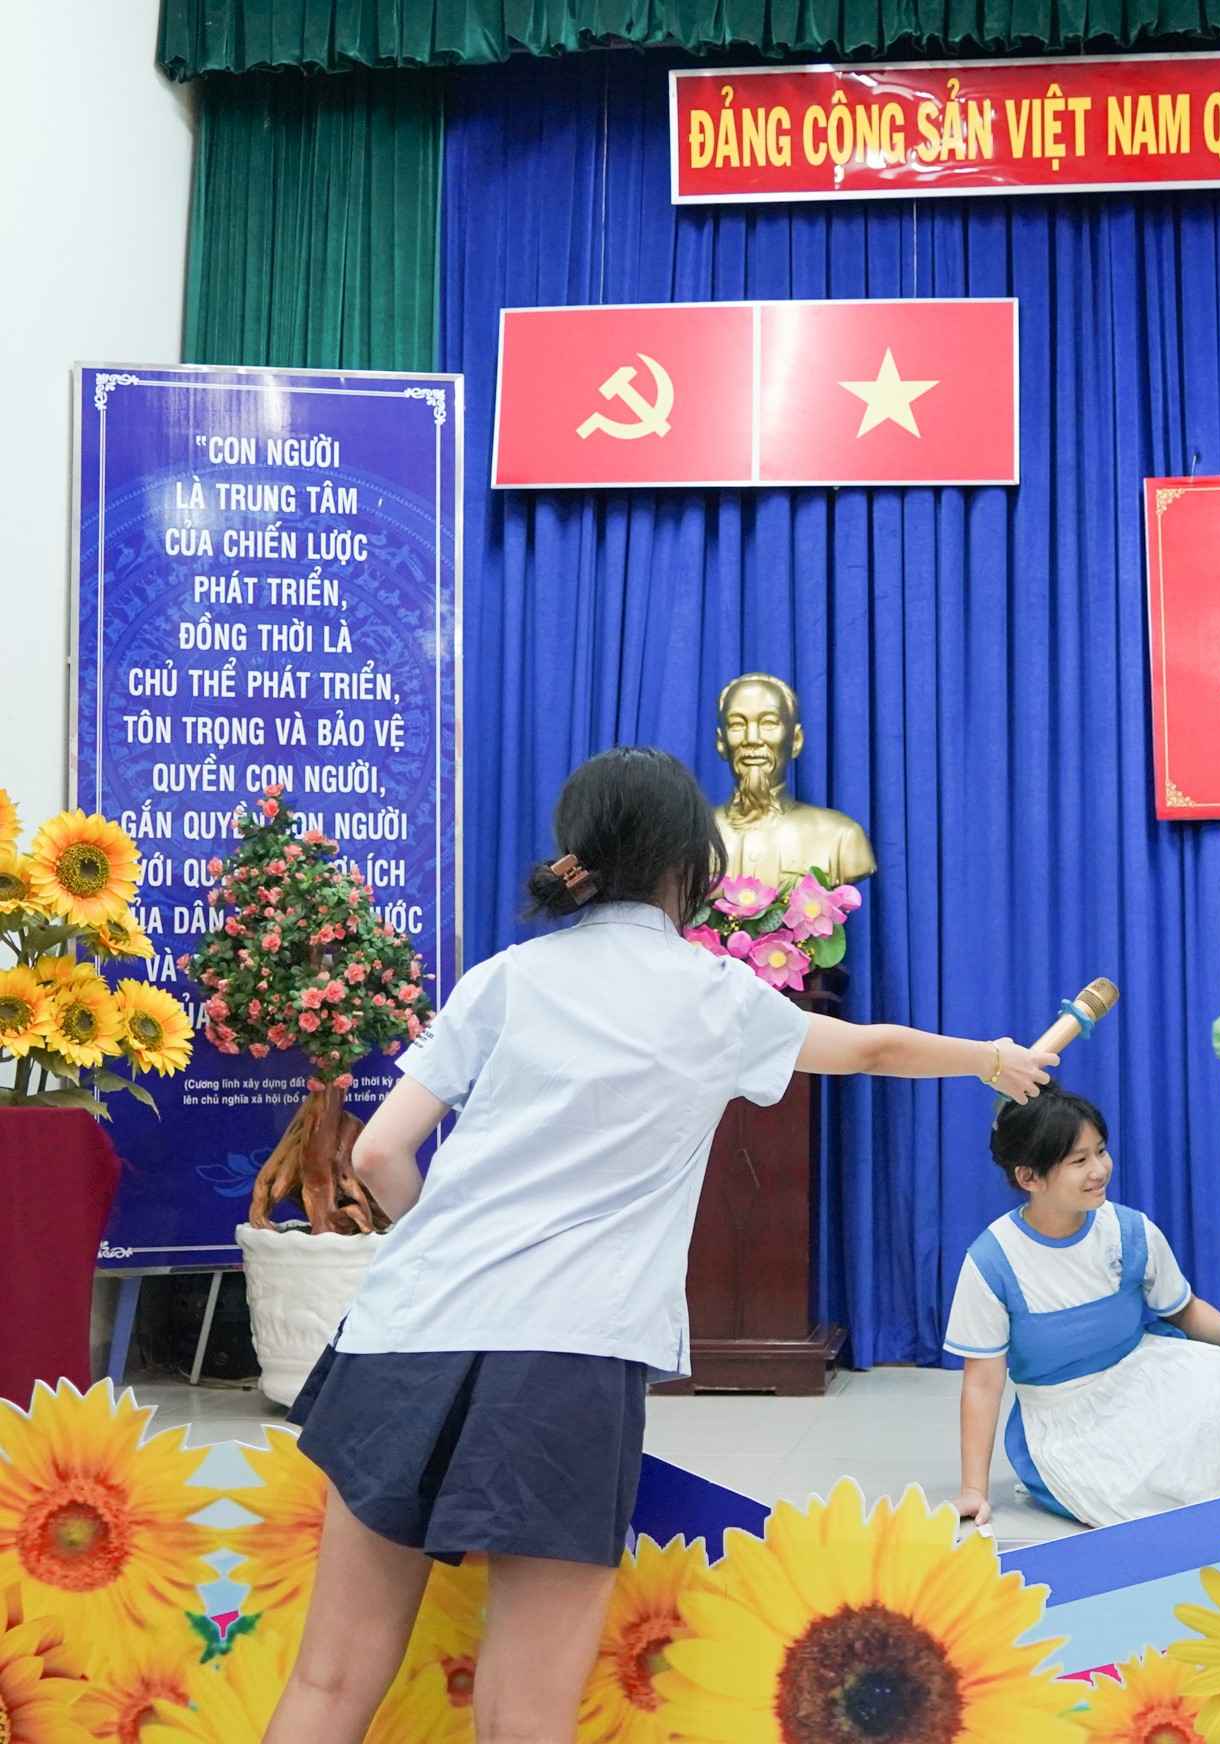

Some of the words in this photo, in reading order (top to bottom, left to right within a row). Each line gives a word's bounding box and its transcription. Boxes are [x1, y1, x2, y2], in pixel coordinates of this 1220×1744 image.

[689, 85, 792, 168] ĐẢNG
[803, 90, 905, 185] CỘNG
[917, 78, 994, 162] SẢN
[1005, 83, 1092, 171] VIỆT
[1107, 94, 1191, 156] NAM
[267, 434, 340, 468] NGƯỜI
[176, 476, 204, 511] LÀ
[216, 483, 296, 514] TRUNG
[306, 480, 358, 515] TÂM
[165, 520, 213, 557] CỦA
[223, 522, 297, 560] CHIẾN
[307, 529, 368, 566] LƯỢC
[194, 570, 257, 605] PHÁT
[267, 567, 347, 610] TRIỂN,
[179, 612, 247, 652] ĐỒNG
[258, 619, 313, 653] THỜI
[323, 618, 352, 653] LÀ
[129, 660, 177, 697] CHỦ
[189, 657, 237, 698] THỂ
[247, 664, 311, 700] PHÁT
[320, 660, 401, 705] TRIỂN,
[124, 710, 171, 744] TÔN
[182, 716, 265, 750] TRỌNG
[275, 711, 307, 746] VÀ
[318, 710, 365, 747] BẢO
[375, 714, 405, 752] VỆ
[153, 753, 235, 795] QUYỀN
[246, 764, 294, 793] CON
[305, 760, 386, 798] NGƯỜI,
[121, 800, 172, 840] GẮN
[285, 812, 323, 840] ON
[335, 806, 408, 840] NGƯỜI
[367, 852, 406, 887] ÍCH
[174, 899, 225, 934] DÂN
[145, 947, 177, 982] VÀ
